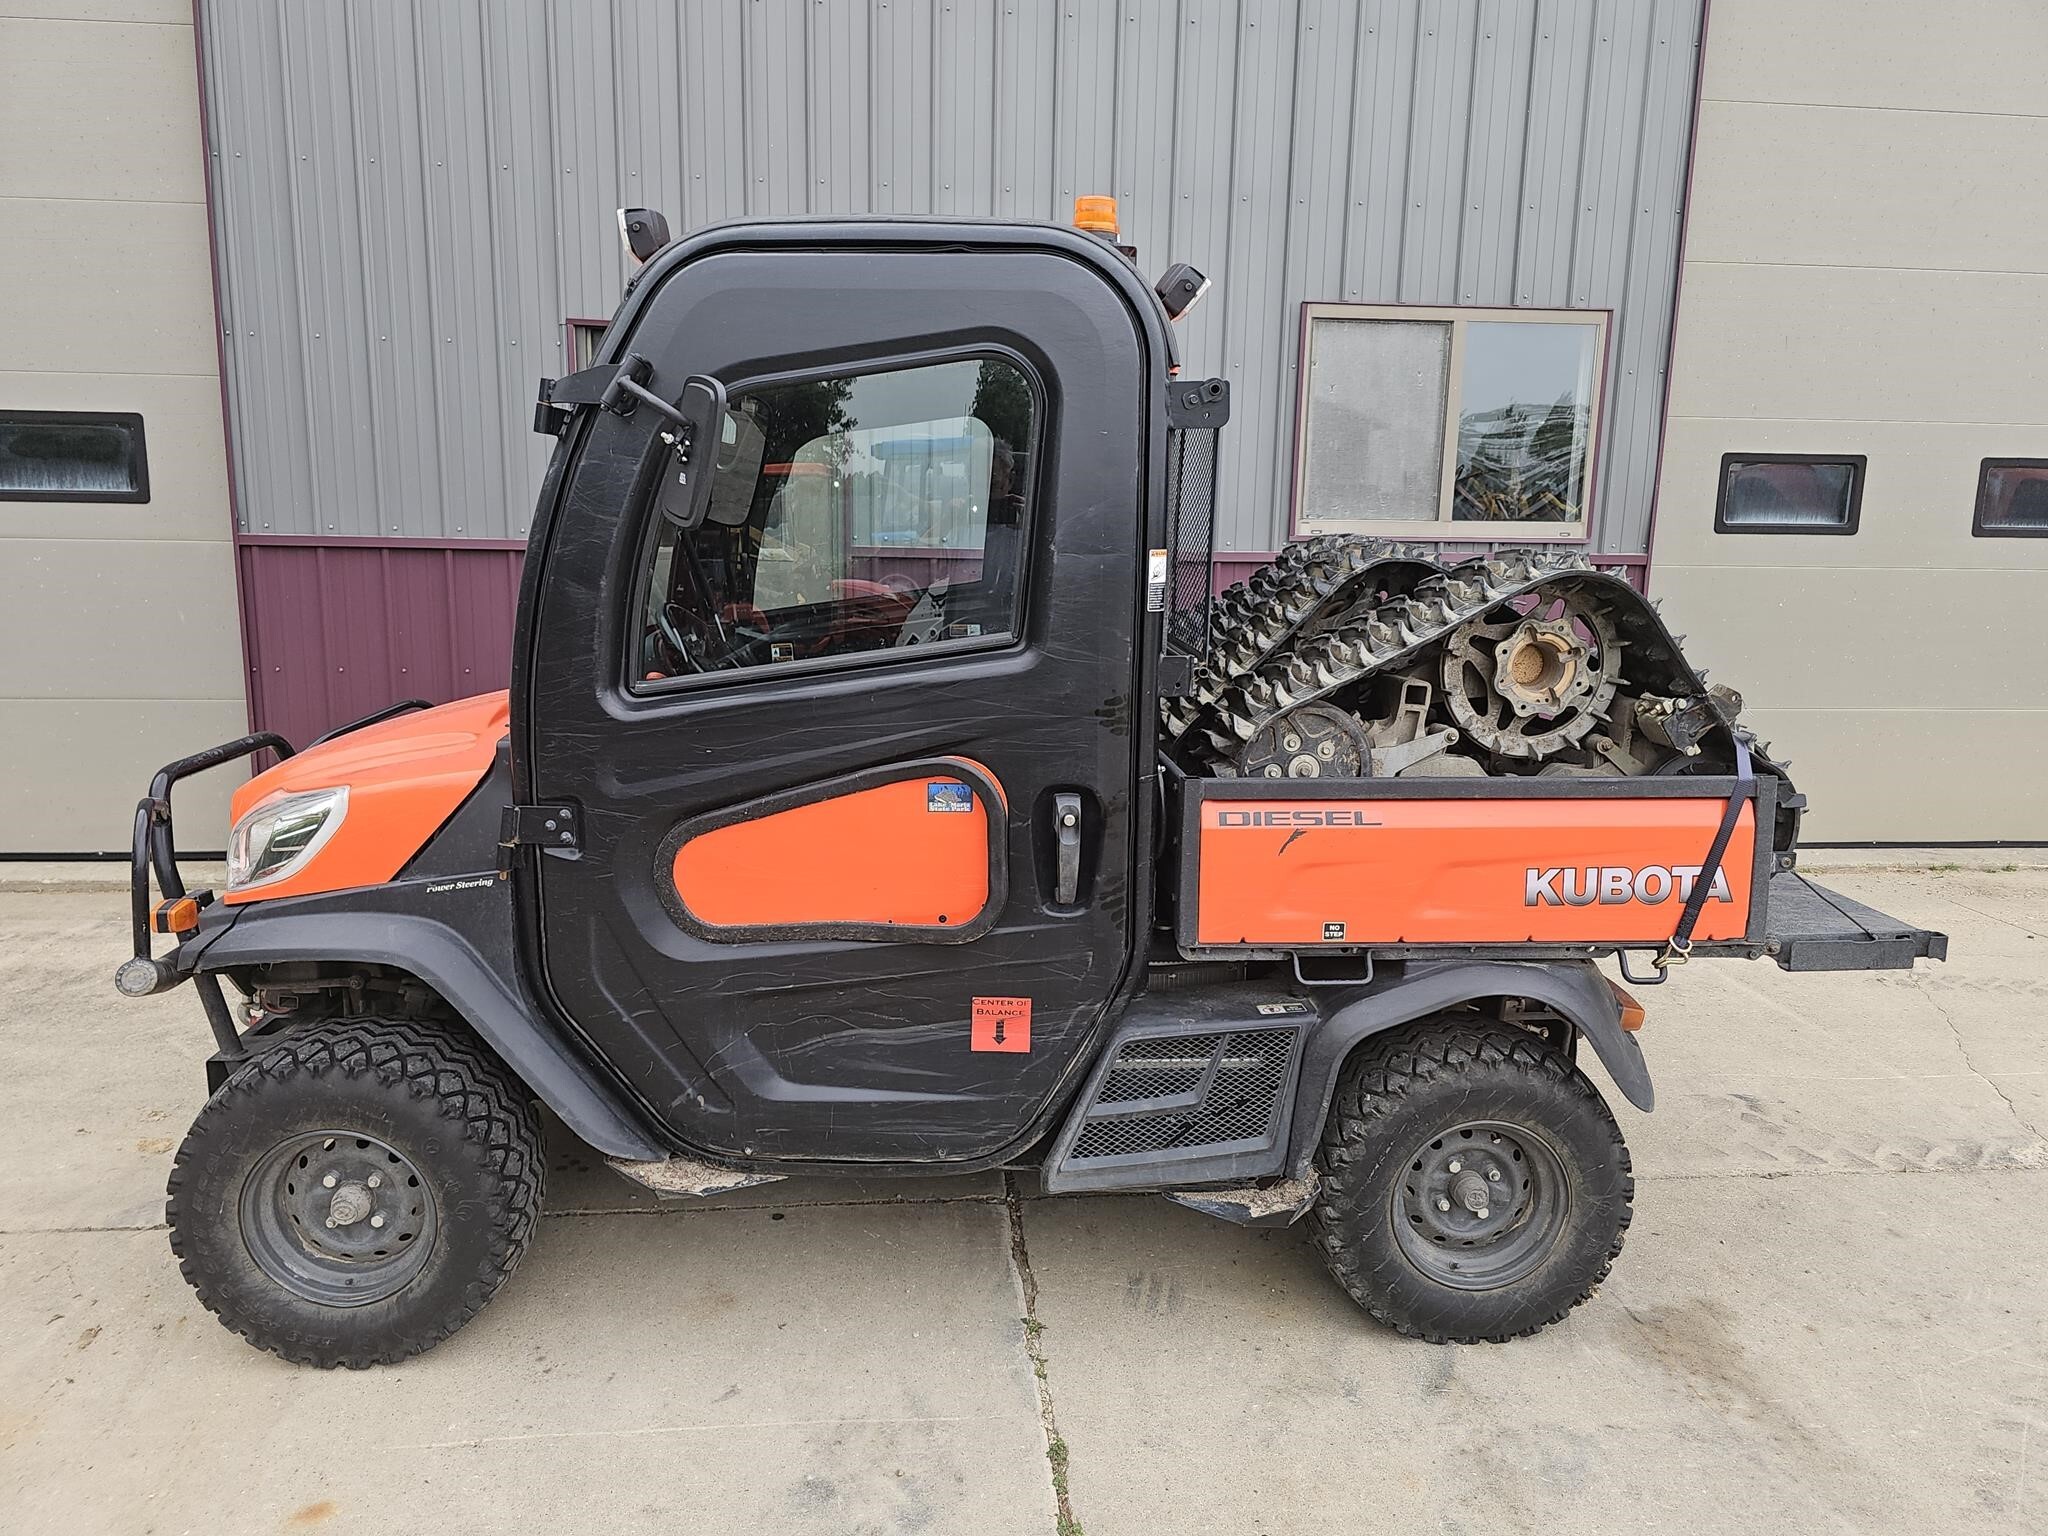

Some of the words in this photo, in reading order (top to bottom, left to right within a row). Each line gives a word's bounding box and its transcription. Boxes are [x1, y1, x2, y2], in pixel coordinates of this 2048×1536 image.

[1218, 810, 1382, 827] DIESEL
[455, 878, 494, 890] Steering
[1524, 865, 1733, 907] KUBOTA
[972, 998, 1014, 1007] CENTER
[976, 1008, 1025, 1016] BALANCE
